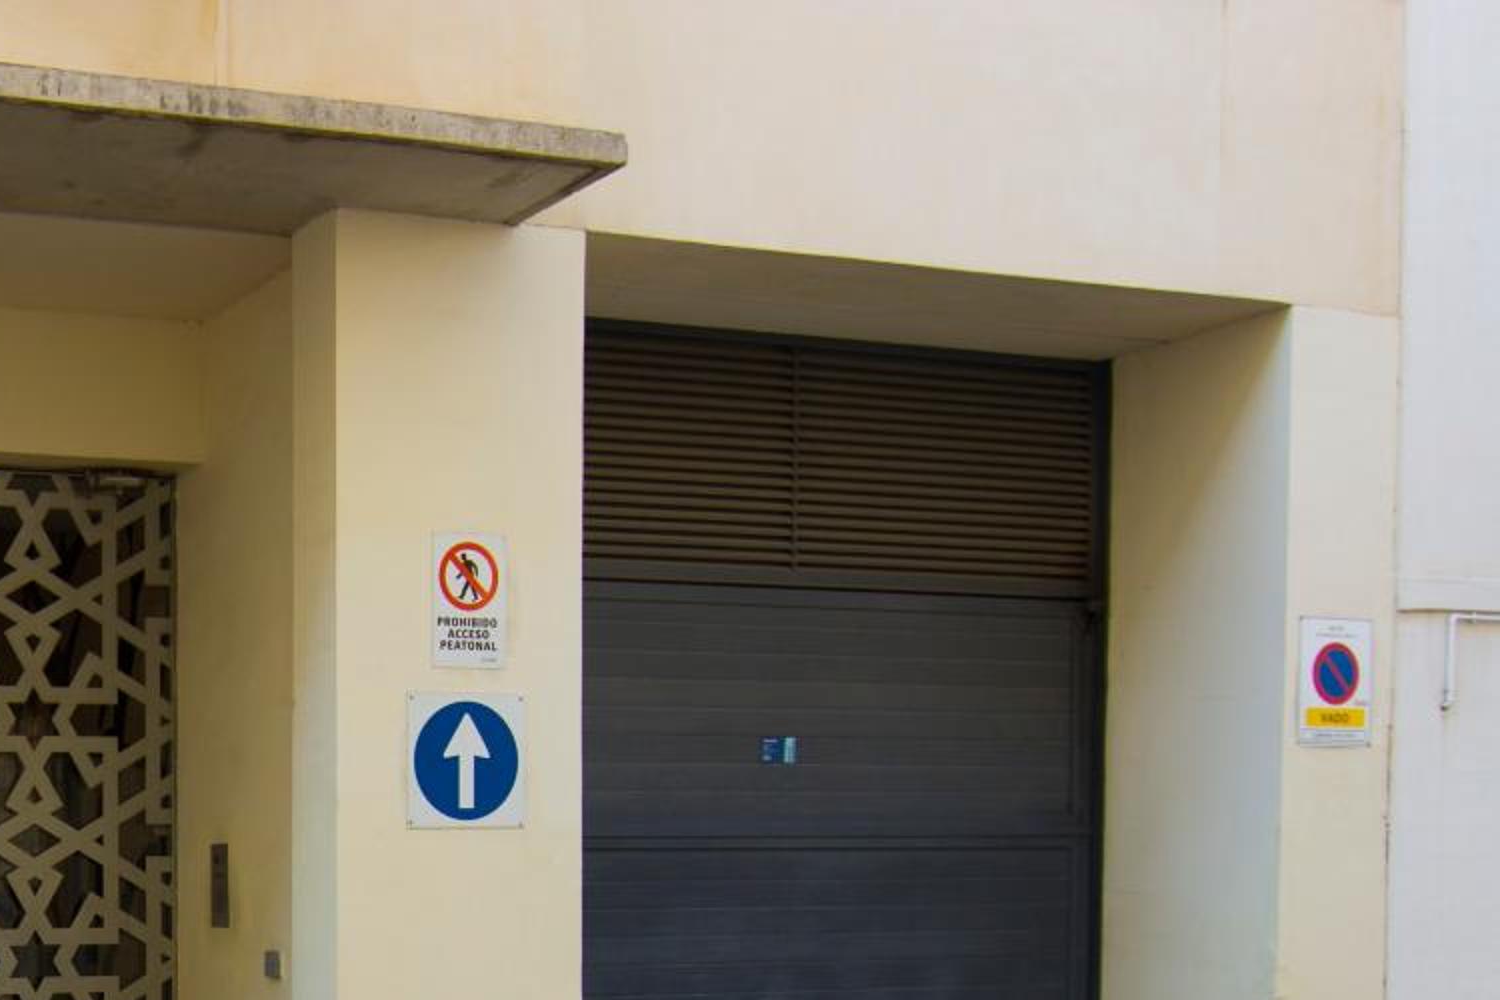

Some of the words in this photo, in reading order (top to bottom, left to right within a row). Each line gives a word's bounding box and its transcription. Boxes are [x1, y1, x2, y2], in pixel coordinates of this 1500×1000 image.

[437, 617, 497, 628] PROHIBIDO
[448, 629, 489, 639] ACCESO
[440, 640, 497, 651] PEATONAL
